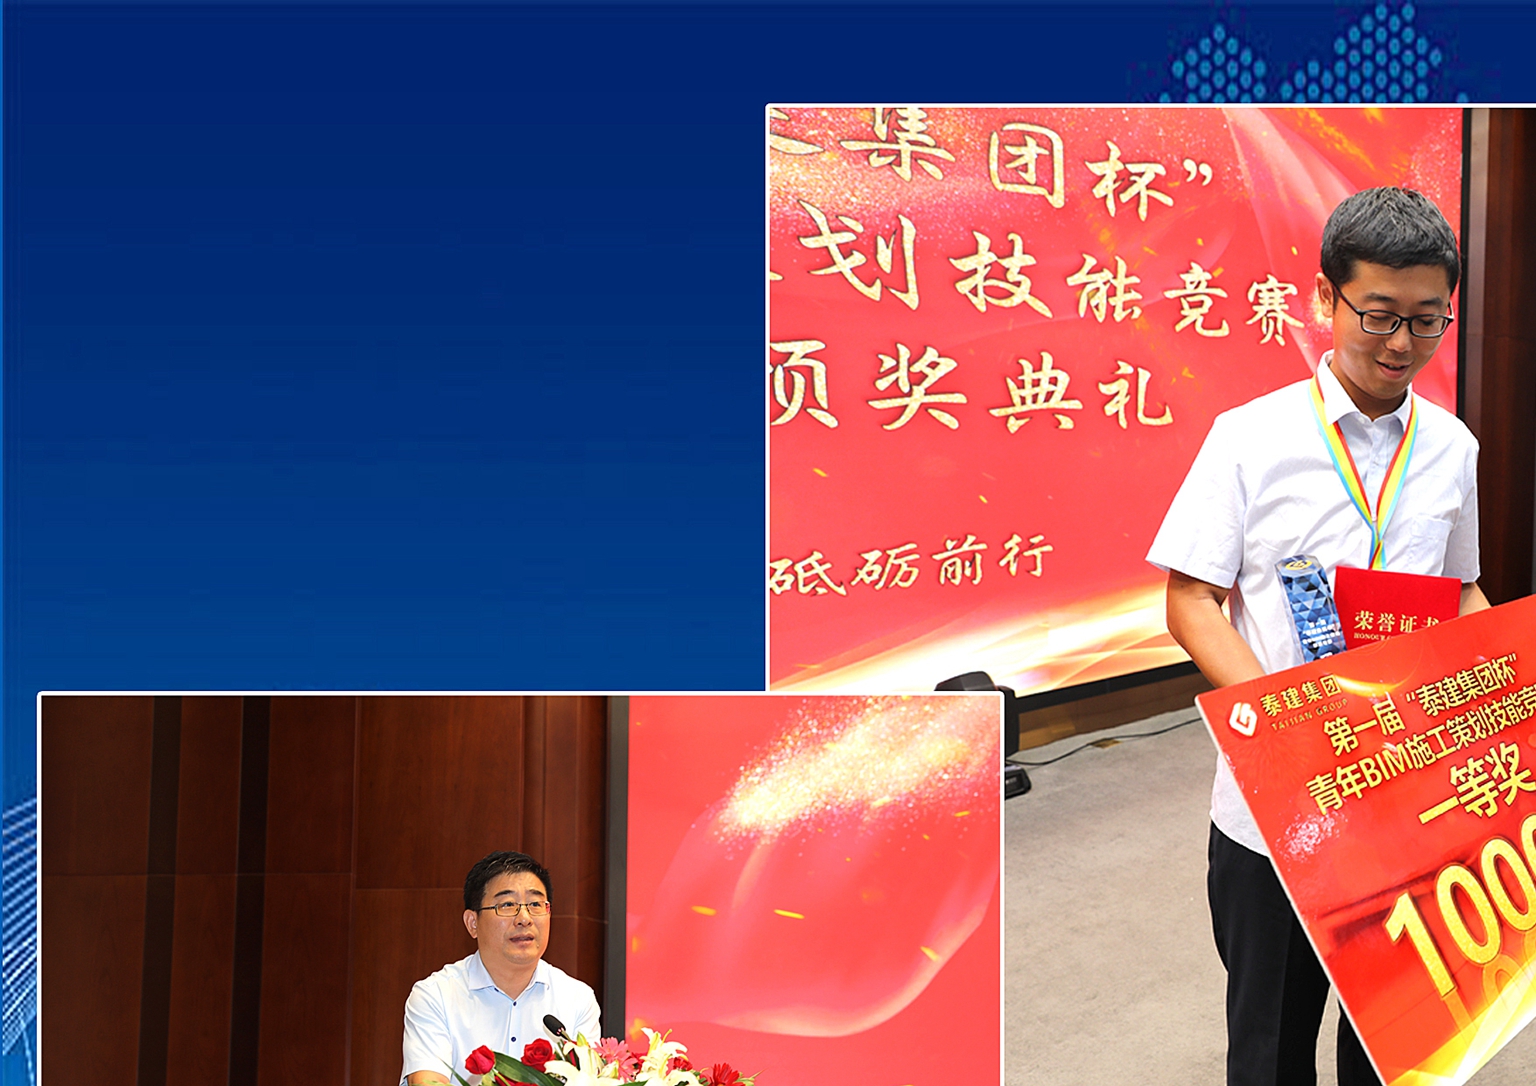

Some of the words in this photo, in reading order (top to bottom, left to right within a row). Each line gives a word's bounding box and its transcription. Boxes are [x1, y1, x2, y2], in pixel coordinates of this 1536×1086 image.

[769, 107, 1213, 221] 集团杯”
[769, 199, 1305, 347] 划技能竞赛
[769, 532, 1055, 598] 砥砺前行
[1259, 674, 1342, 717] 泰建集团
[1270, 711, 1313, 732] TAIJIAN
[1316, 698, 1348, 717] GROUP
[1322, 697, 1406, 757] 第一届
